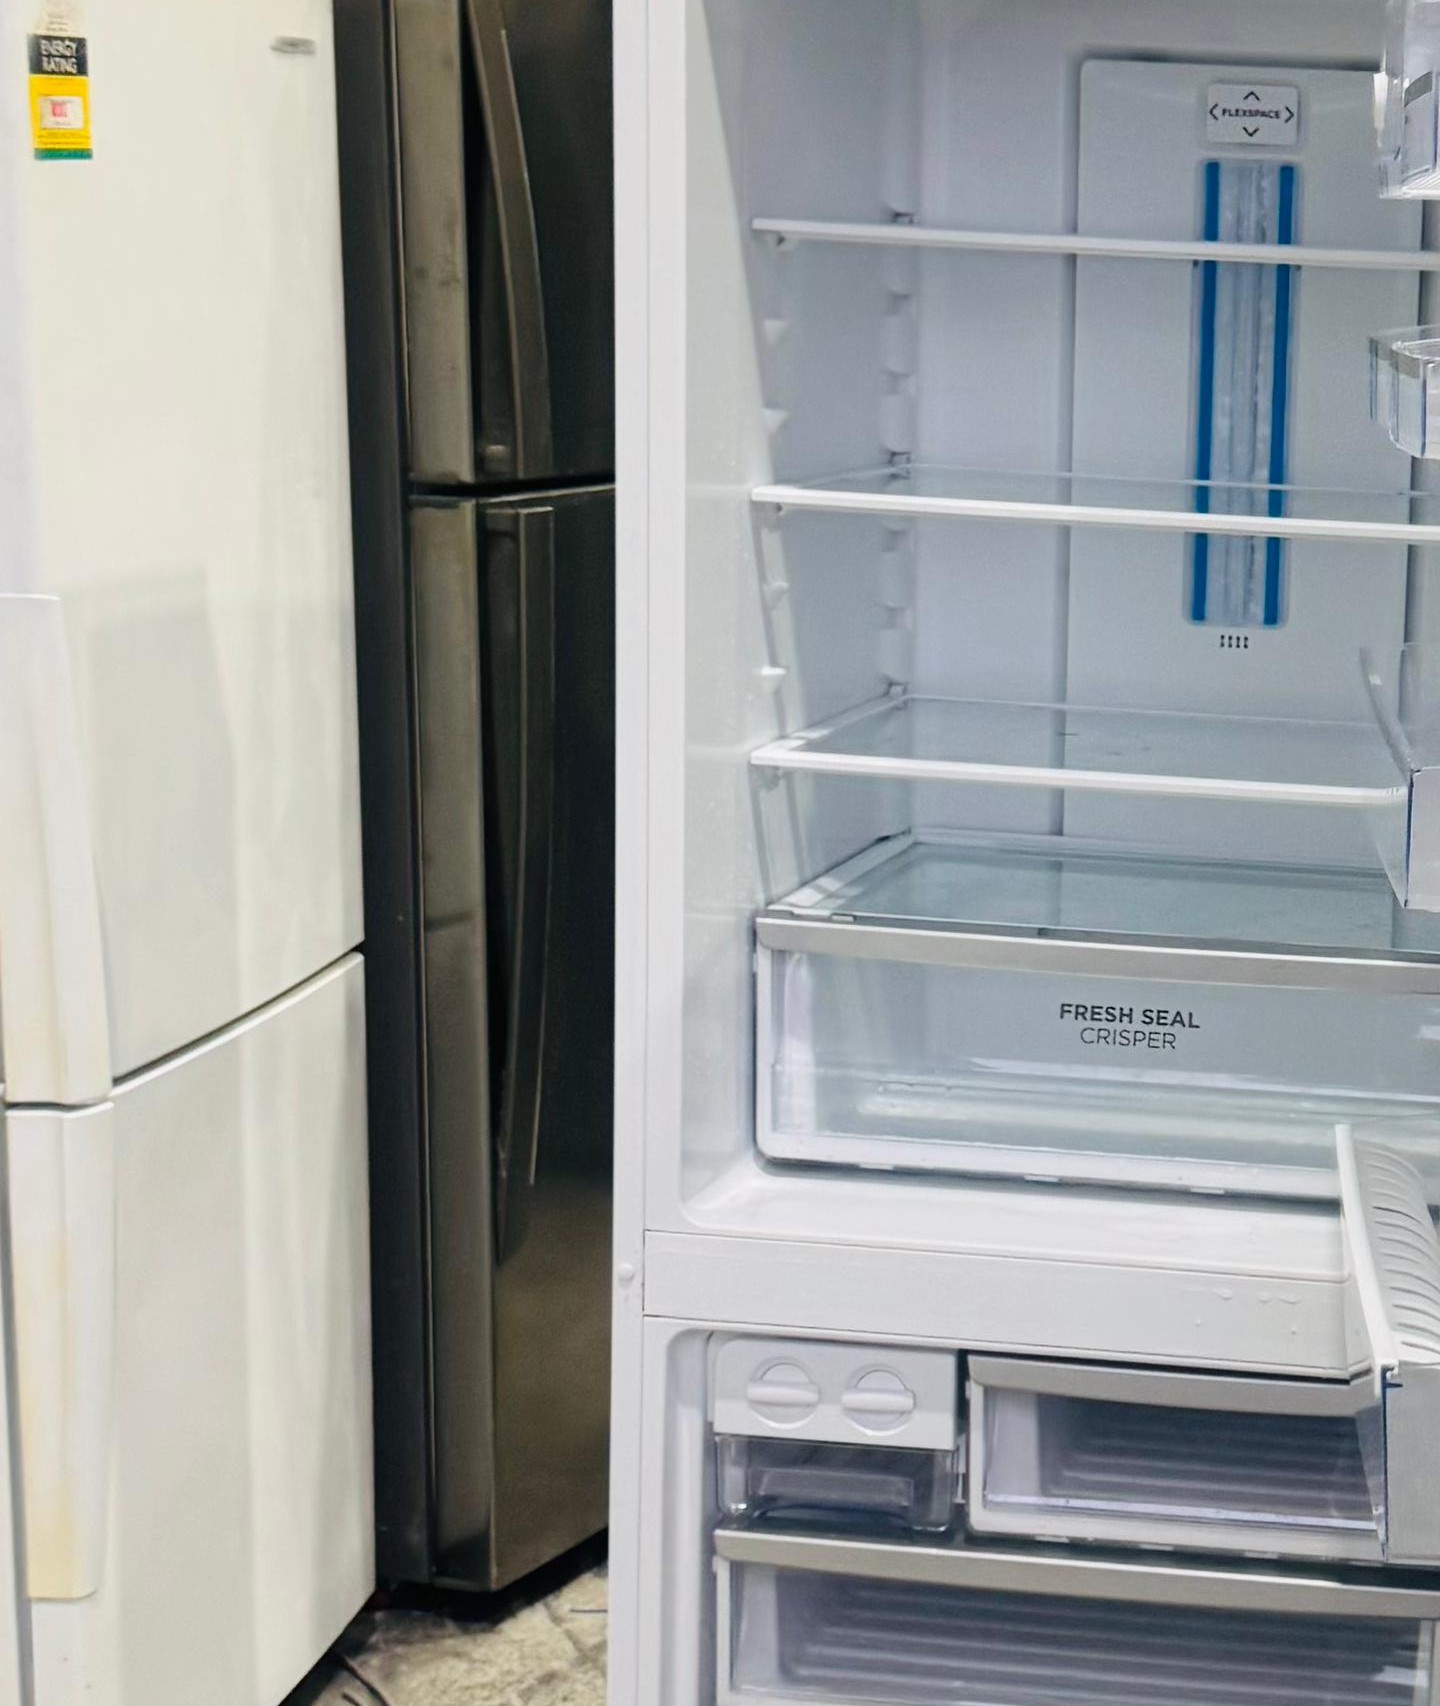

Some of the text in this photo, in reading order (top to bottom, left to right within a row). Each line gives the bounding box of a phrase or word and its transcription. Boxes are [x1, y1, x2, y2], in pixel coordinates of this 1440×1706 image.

[1222, 107, 1281, 119] FLEXSPACE
[1060, 1003, 1200, 1028] FRESH SEAL
[1080, 1027, 1176, 1049] CRISPER
